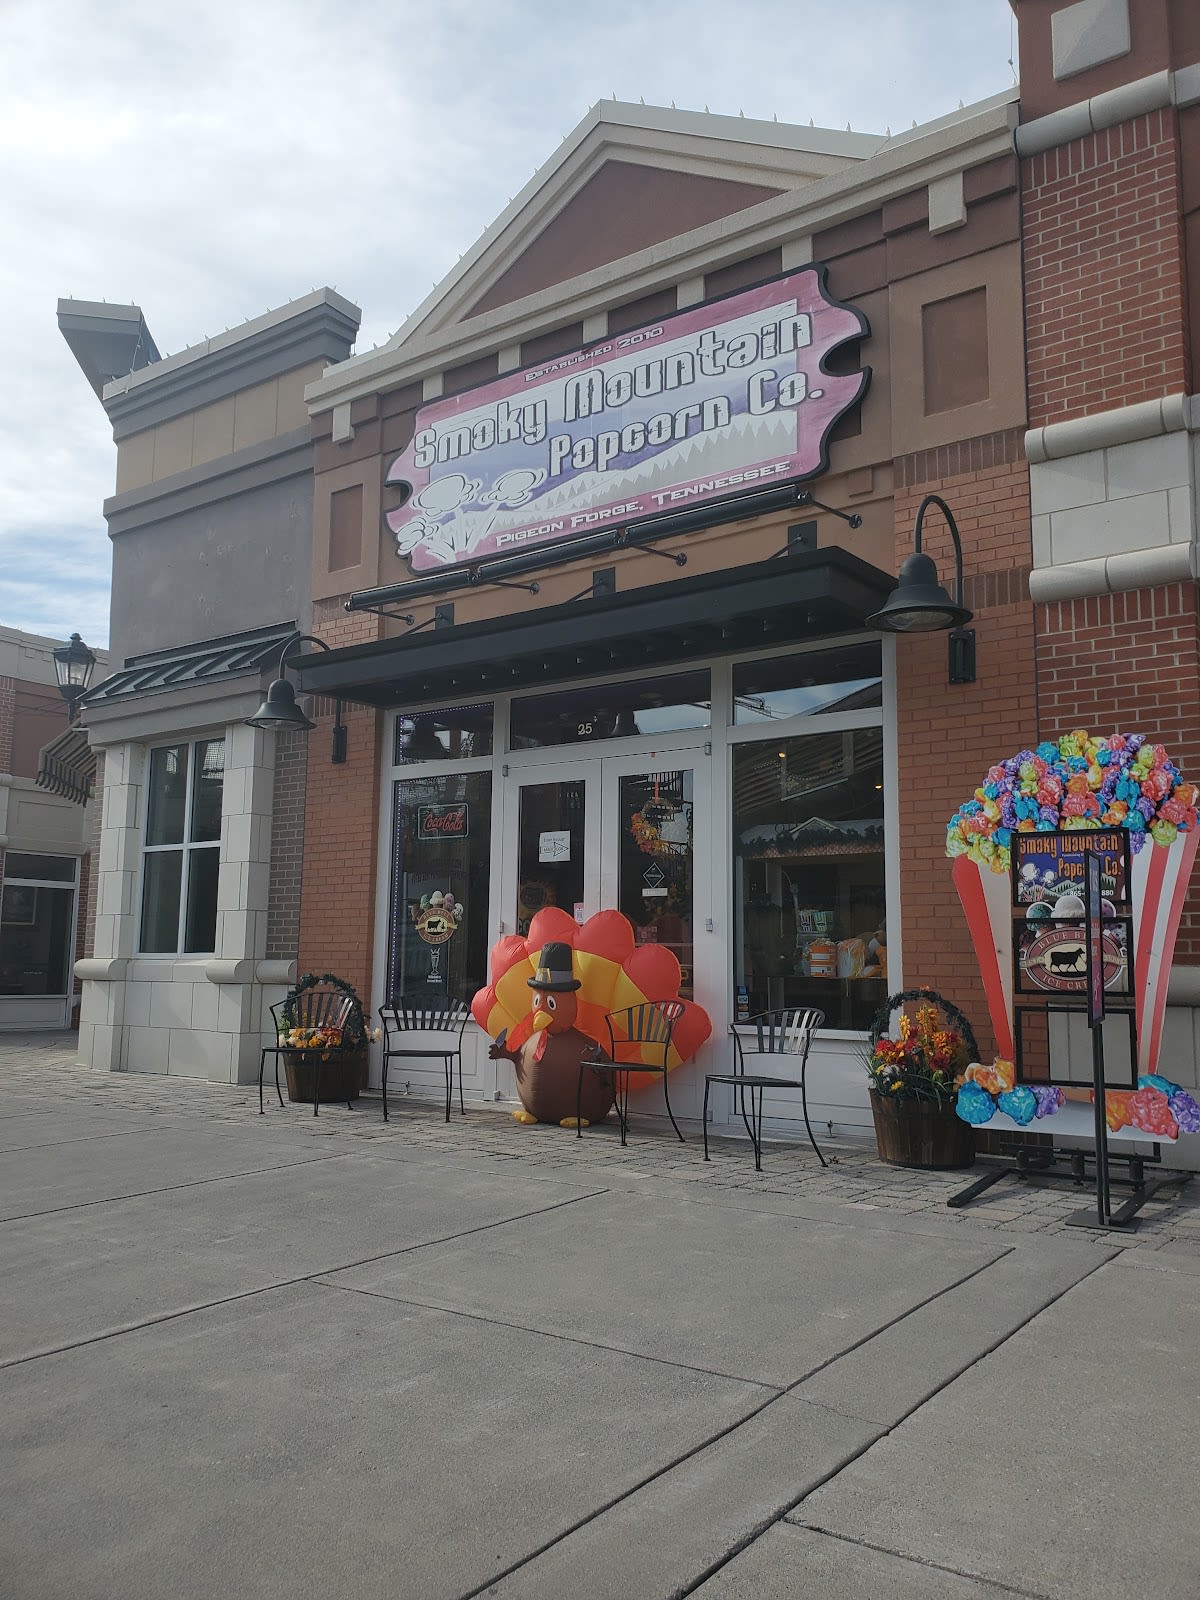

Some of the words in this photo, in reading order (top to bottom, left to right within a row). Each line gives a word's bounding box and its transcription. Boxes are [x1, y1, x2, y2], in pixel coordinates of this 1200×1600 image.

[524, 344, 613, 382] ESTABLISHED
[617, 326, 664, 350] 2010
[414, 399, 547, 469] Smoky
[563, 313, 812, 423] Mountain
[549, 395, 730, 478] Popcorn
[747, 369, 825, 416] Co.
[495, 520, 564, 547] PIGEON
[570, 501, 644, 529] FORGE,
[652, 461, 790, 506] TENNESSEE
[577, 722, 594, 736] 25
[1019, 836, 1057, 858] Smoky
[1061, 834, 1119, 852] Mountain
[1058, 858, 1086, 881] Popc
[1104, 855, 1121, 876] Co.
[1101, 889, 1115, 897] 880
[1038, 931, 1068, 949] BLUE
[1042, 974, 1062, 989] ICE
